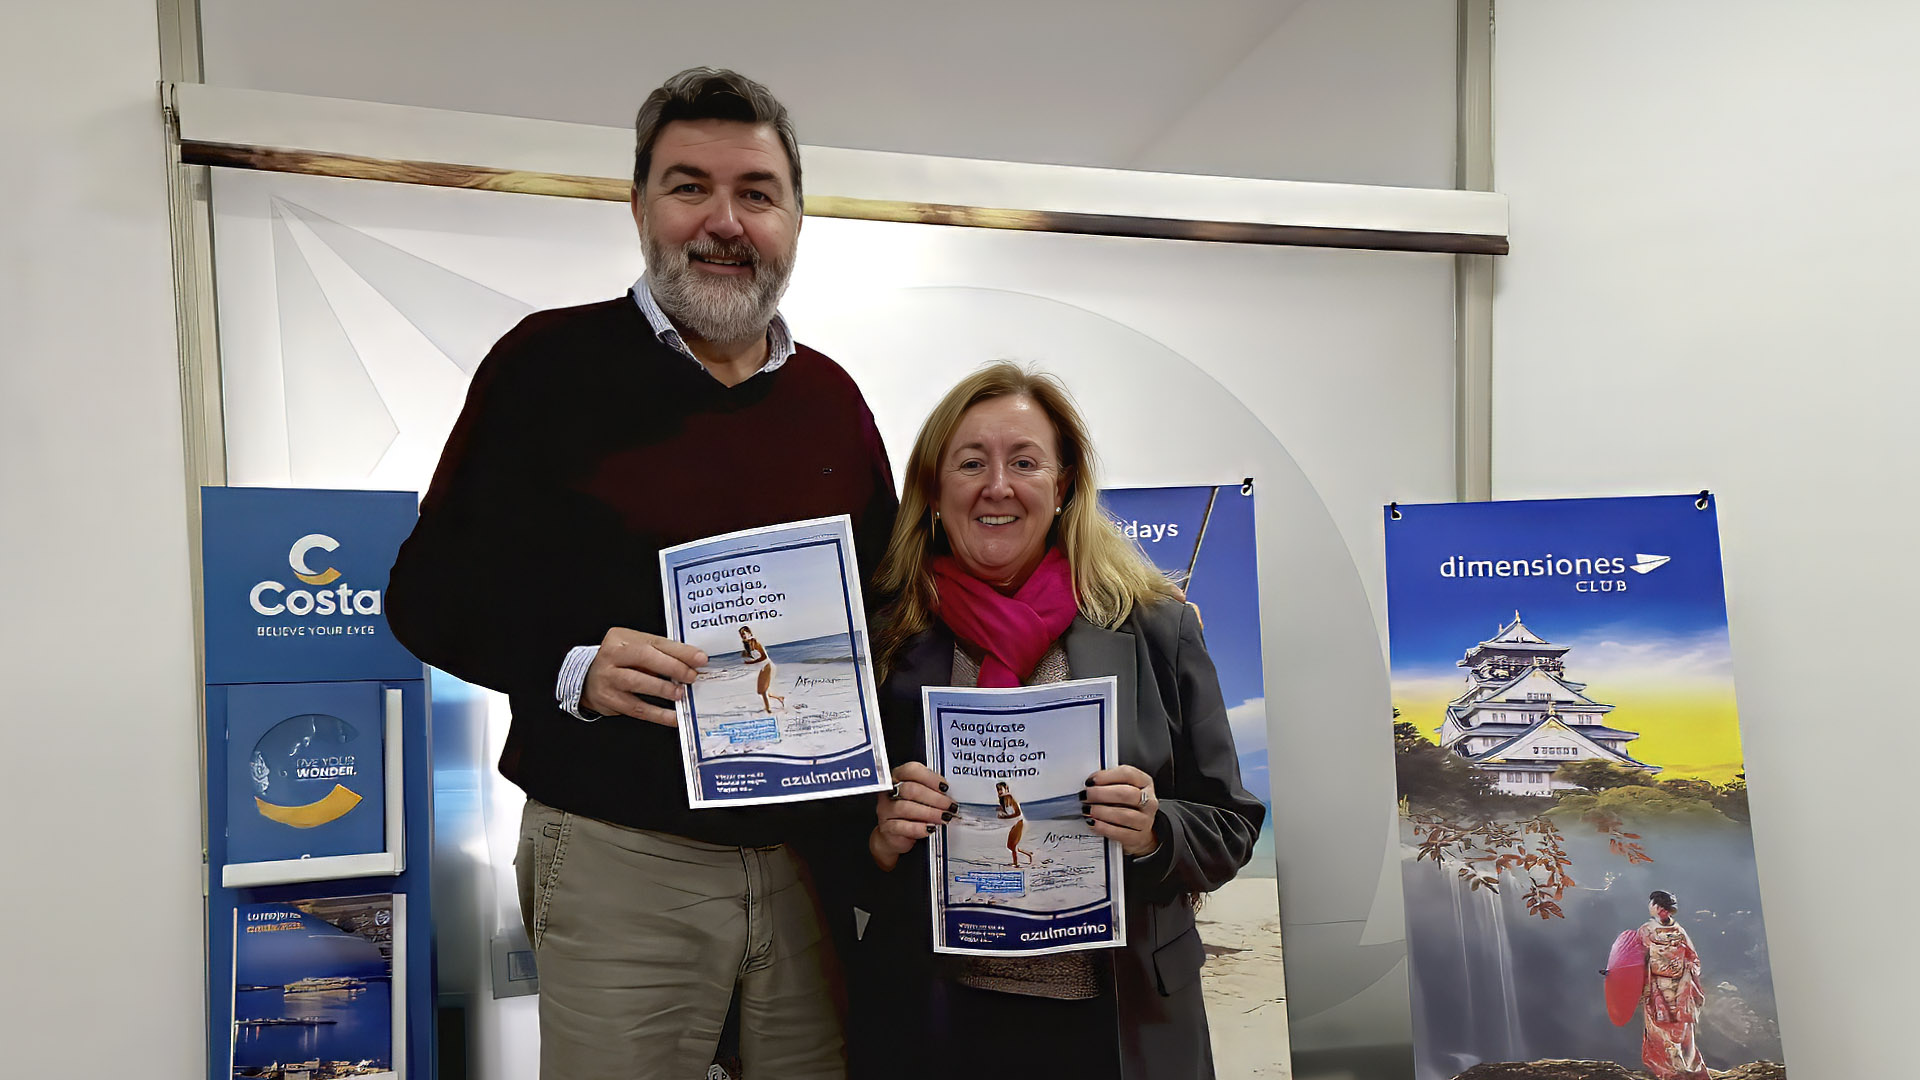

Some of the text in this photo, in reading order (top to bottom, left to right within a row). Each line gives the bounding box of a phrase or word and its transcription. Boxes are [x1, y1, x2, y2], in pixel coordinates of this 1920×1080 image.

[1440, 553, 1626, 578] dimensiones
[1575, 580, 1627, 592] CLUB
[249, 580, 382, 616] Costa
[689, 592, 786, 615] viajando con
[257, 625, 375, 637] BELIEVE YOUR EYES
[951, 750, 1046, 766] viajando con
[781, 767, 871, 788] azulmarino
[1020, 922, 1107, 942] azulmarino
